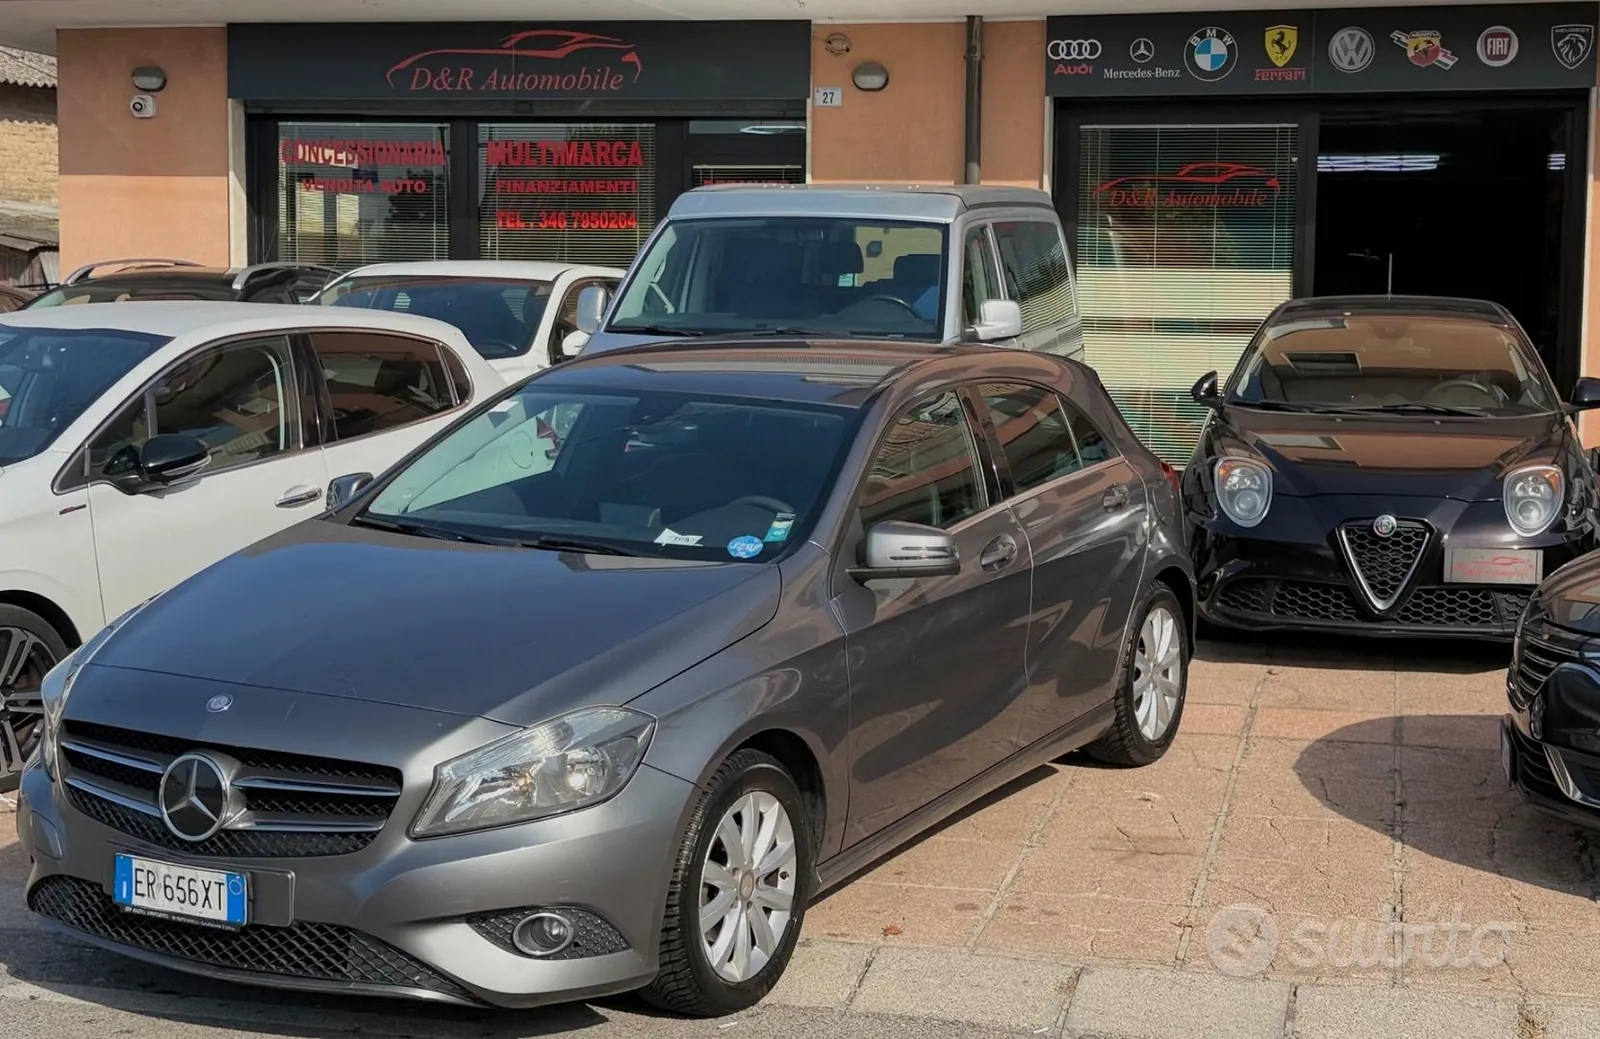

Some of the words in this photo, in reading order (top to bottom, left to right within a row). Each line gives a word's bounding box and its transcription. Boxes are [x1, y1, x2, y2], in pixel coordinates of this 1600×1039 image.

[1190, 29, 1233, 46] BMW
[1487, 38, 1508, 55] FIAT
[1053, 64, 1093, 75] Audi
[1103, 68, 1181, 79] Mercedes-Benz
[1254, 68, 1306, 81] Ferrari
[409, 68, 474, 91] D&R
[480, 68, 624, 91] Automobile
[822, 92, 835, 104] 27
[282, 138, 447, 166] CONCESSIONARIA
[487, 140, 644, 167] MULTIMARCA
[302, 178, 374, 192] VENDITA
[380, 180, 427, 193] AUTO
[496, 180, 637, 193] FINANZIAMENTI
[134, 868, 156, 900] ER
[163, 875, 225, 911] 656XT
